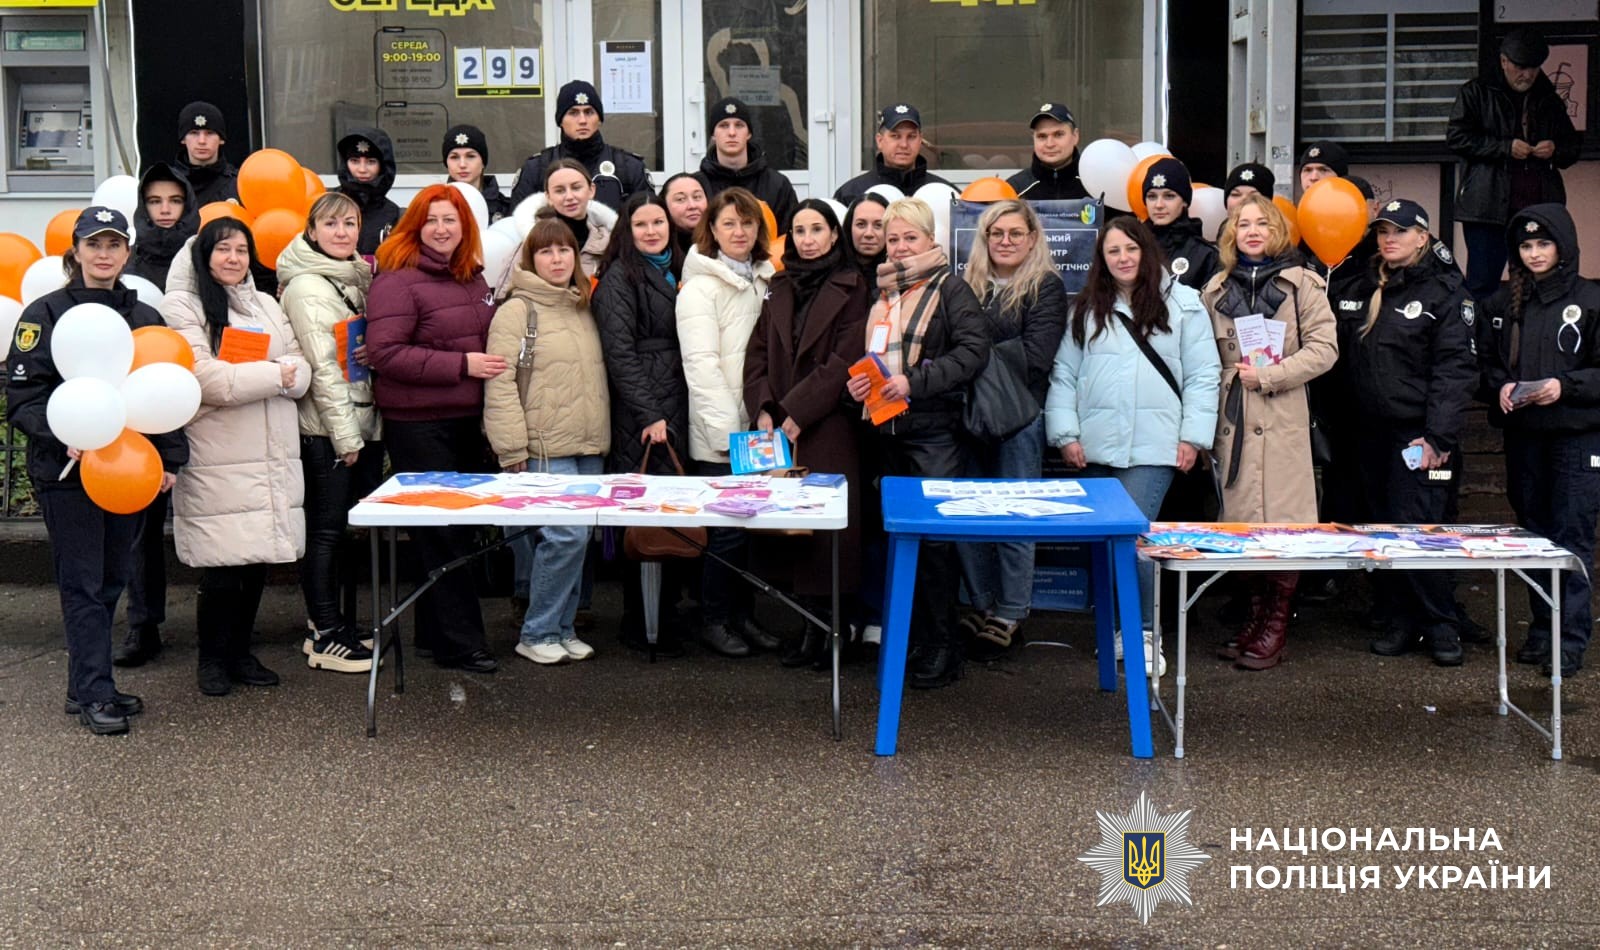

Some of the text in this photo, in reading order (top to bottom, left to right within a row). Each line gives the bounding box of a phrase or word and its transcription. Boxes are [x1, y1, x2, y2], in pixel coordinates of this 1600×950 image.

[391, 41, 428, 49] СЕРЕДА
[382, 52, 441, 62] 9:00-19:00
[1046, 233, 1072, 242] ЬКИЙ
[1050, 249, 1068, 257] НТР
